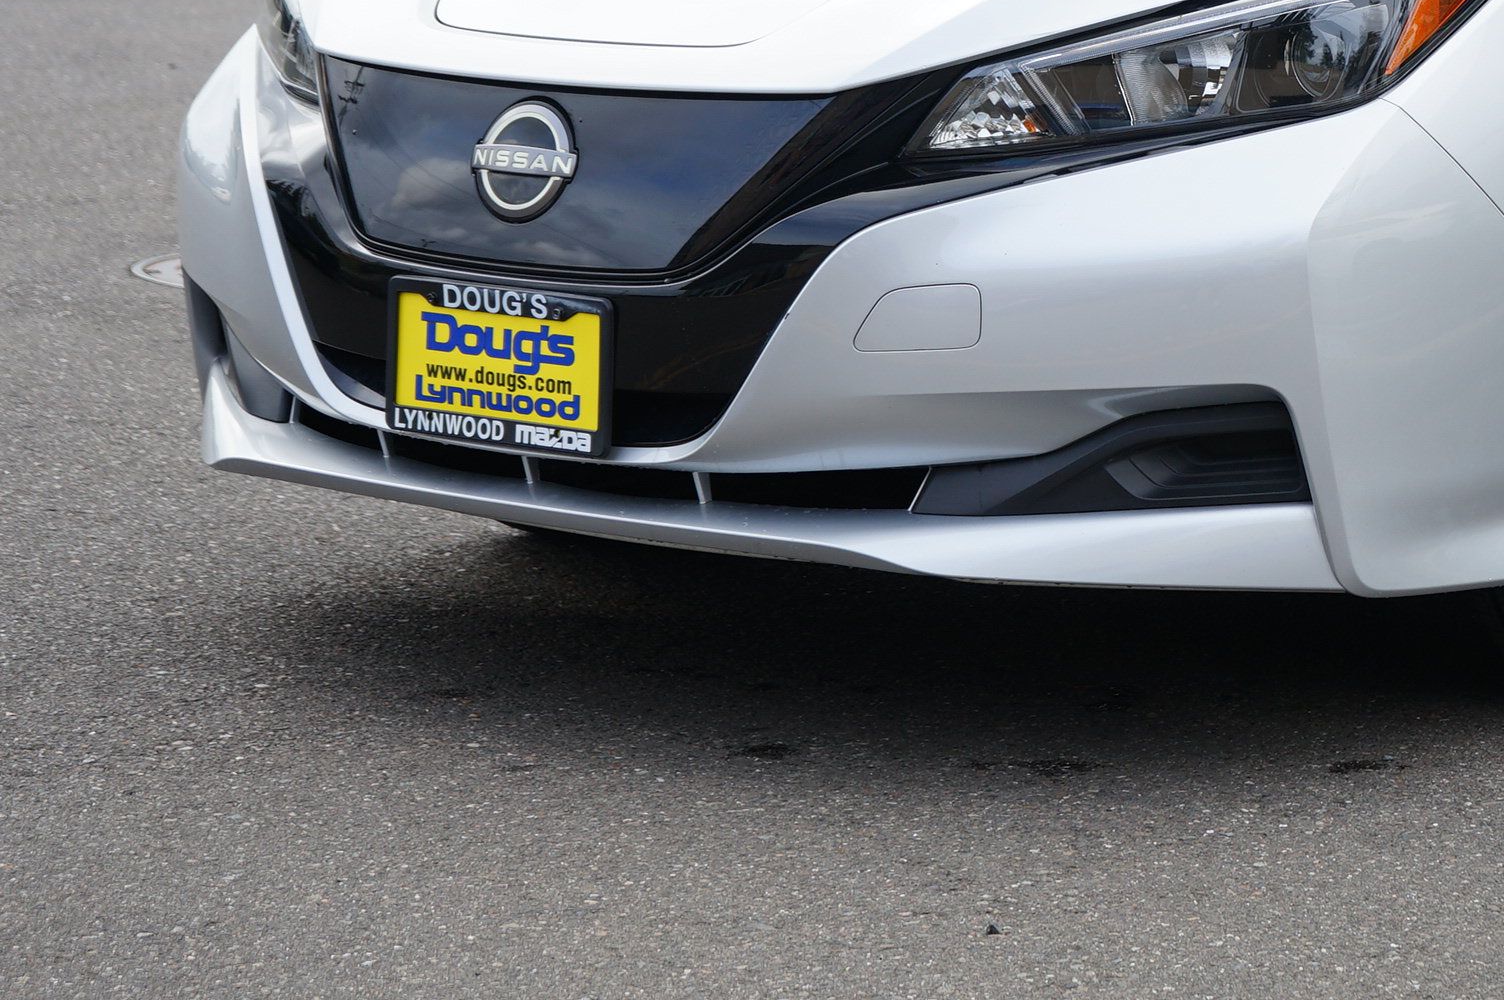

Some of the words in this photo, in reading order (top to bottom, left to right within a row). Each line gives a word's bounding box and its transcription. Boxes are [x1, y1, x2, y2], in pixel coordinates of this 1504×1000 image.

[473, 149, 573, 174] NISSAN
[442, 284, 548, 319] DOUG'S
[426, 363, 572, 395] www.dougs.com
[415, 374, 580, 421] Lynnwood
[394, 407, 504, 441] LYNNWOOD
